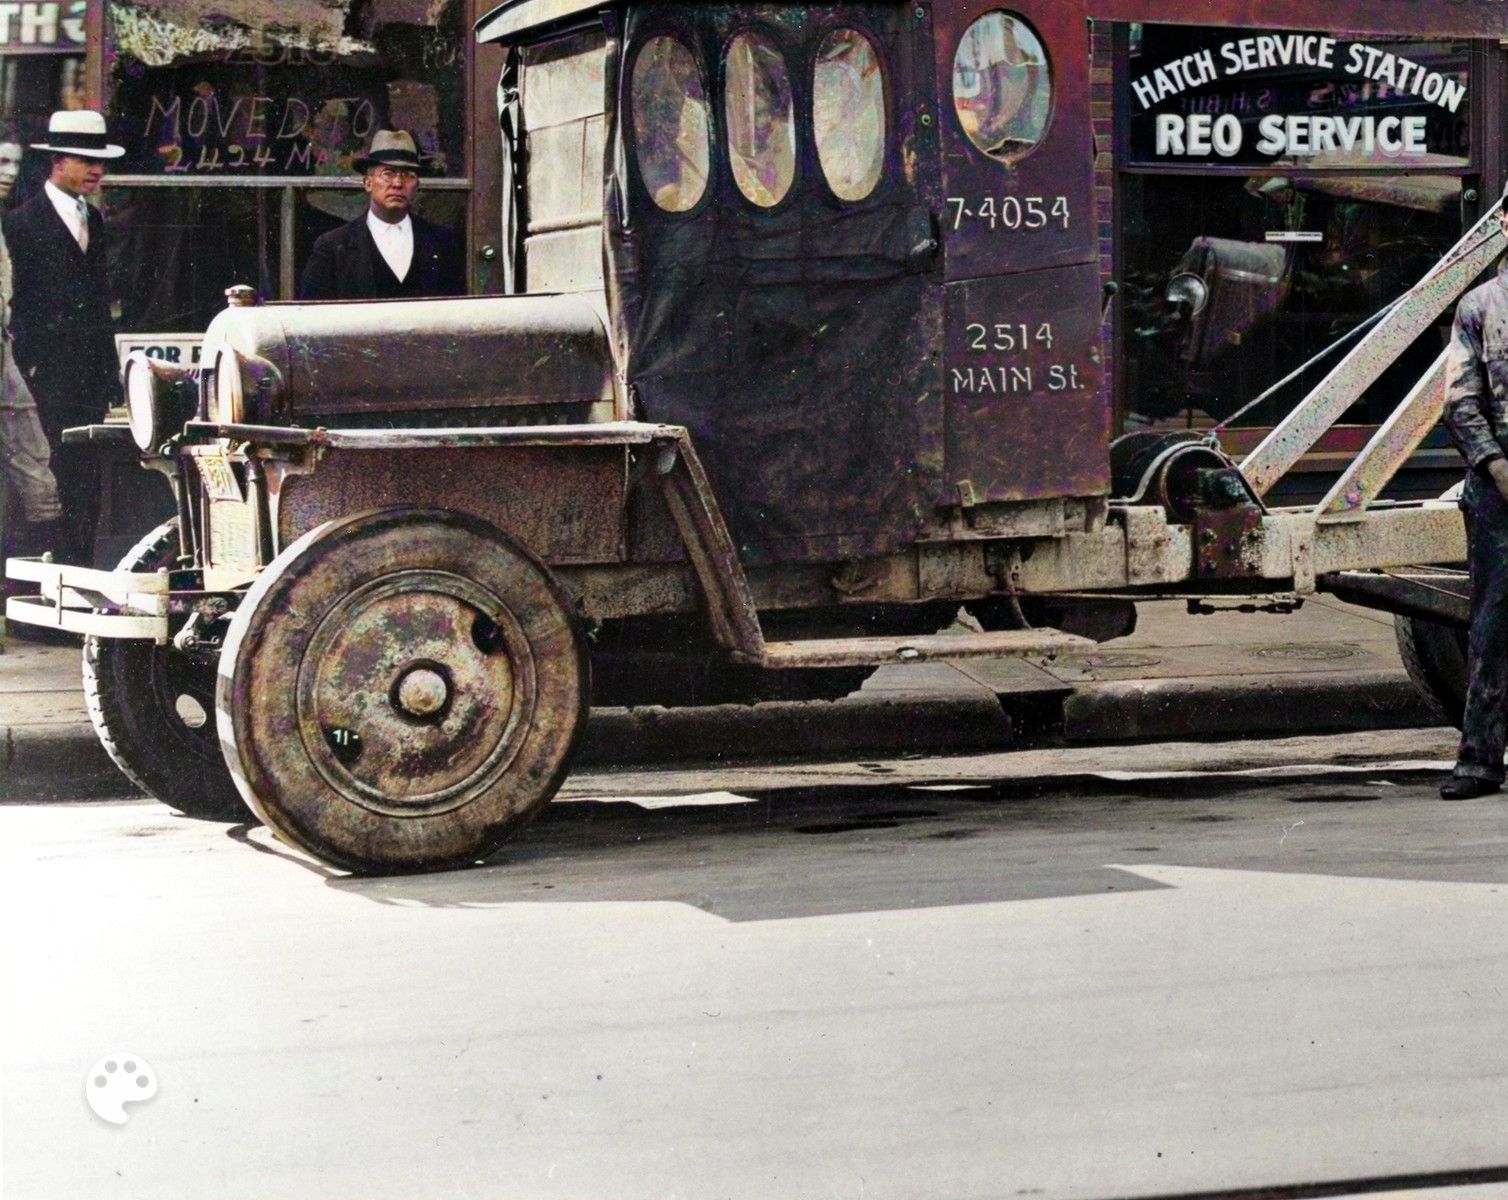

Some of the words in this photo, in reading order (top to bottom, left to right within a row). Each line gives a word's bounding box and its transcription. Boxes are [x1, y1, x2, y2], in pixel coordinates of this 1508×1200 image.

[1130, 48, 1218, 111] HATCH
[1220, 34, 1337, 76] SERVICE
[1344, 43, 1466, 114] STATION
[143, 94, 310, 140] MOVED
[325, 95, 375, 138] TO
[1155, 113, 1243, 157] REO
[1256, 113, 1428, 157] SERVICE
[160, 143, 276, 172] 2424
[946, 196, 1070, 229] 7-4054
[966, 323, 1054, 350] 2514
[952, 366, 1033, 393] MAIN
